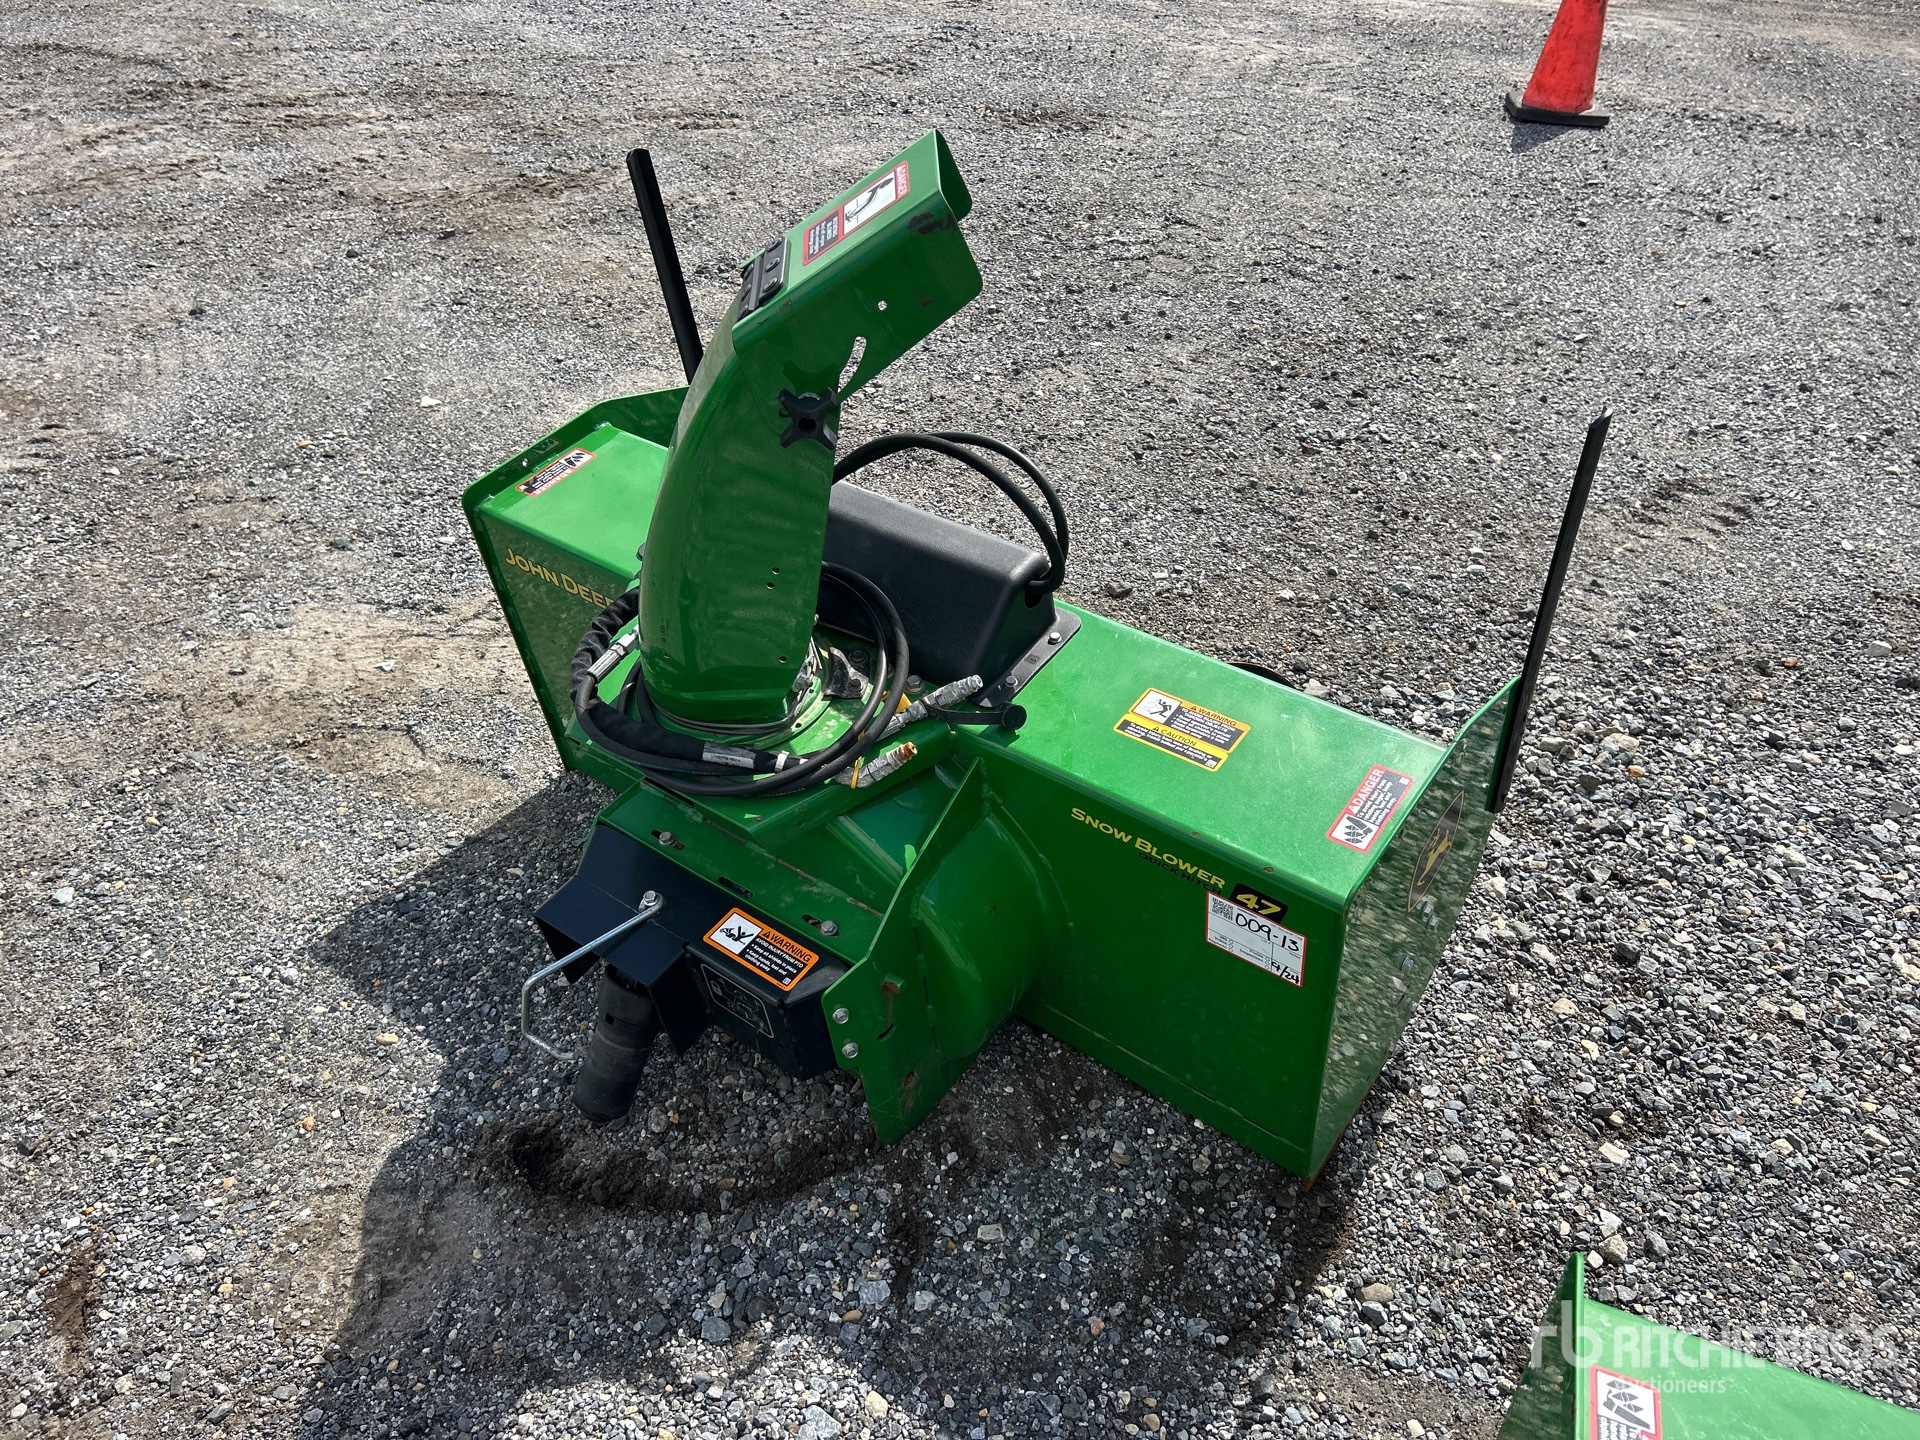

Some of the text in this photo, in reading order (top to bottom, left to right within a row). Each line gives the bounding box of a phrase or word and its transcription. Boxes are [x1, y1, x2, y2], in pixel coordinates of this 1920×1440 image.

[505, 548, 614, 609] JOHN DEE
[1197, 707, 1237, 726] WARNING
[1159, 728, 1197, 747] CAUTION
[1351, 767, 1385, 806] DANGER
[1070, 806, 1226, 889] SNOW BLOWER
[1138, 851, 1179, 876] QUICK
[1236, 893, 1282, 915] 47
[754, 936, 770, 947] AVOID
[768, 933, 814, 963] WARNING
